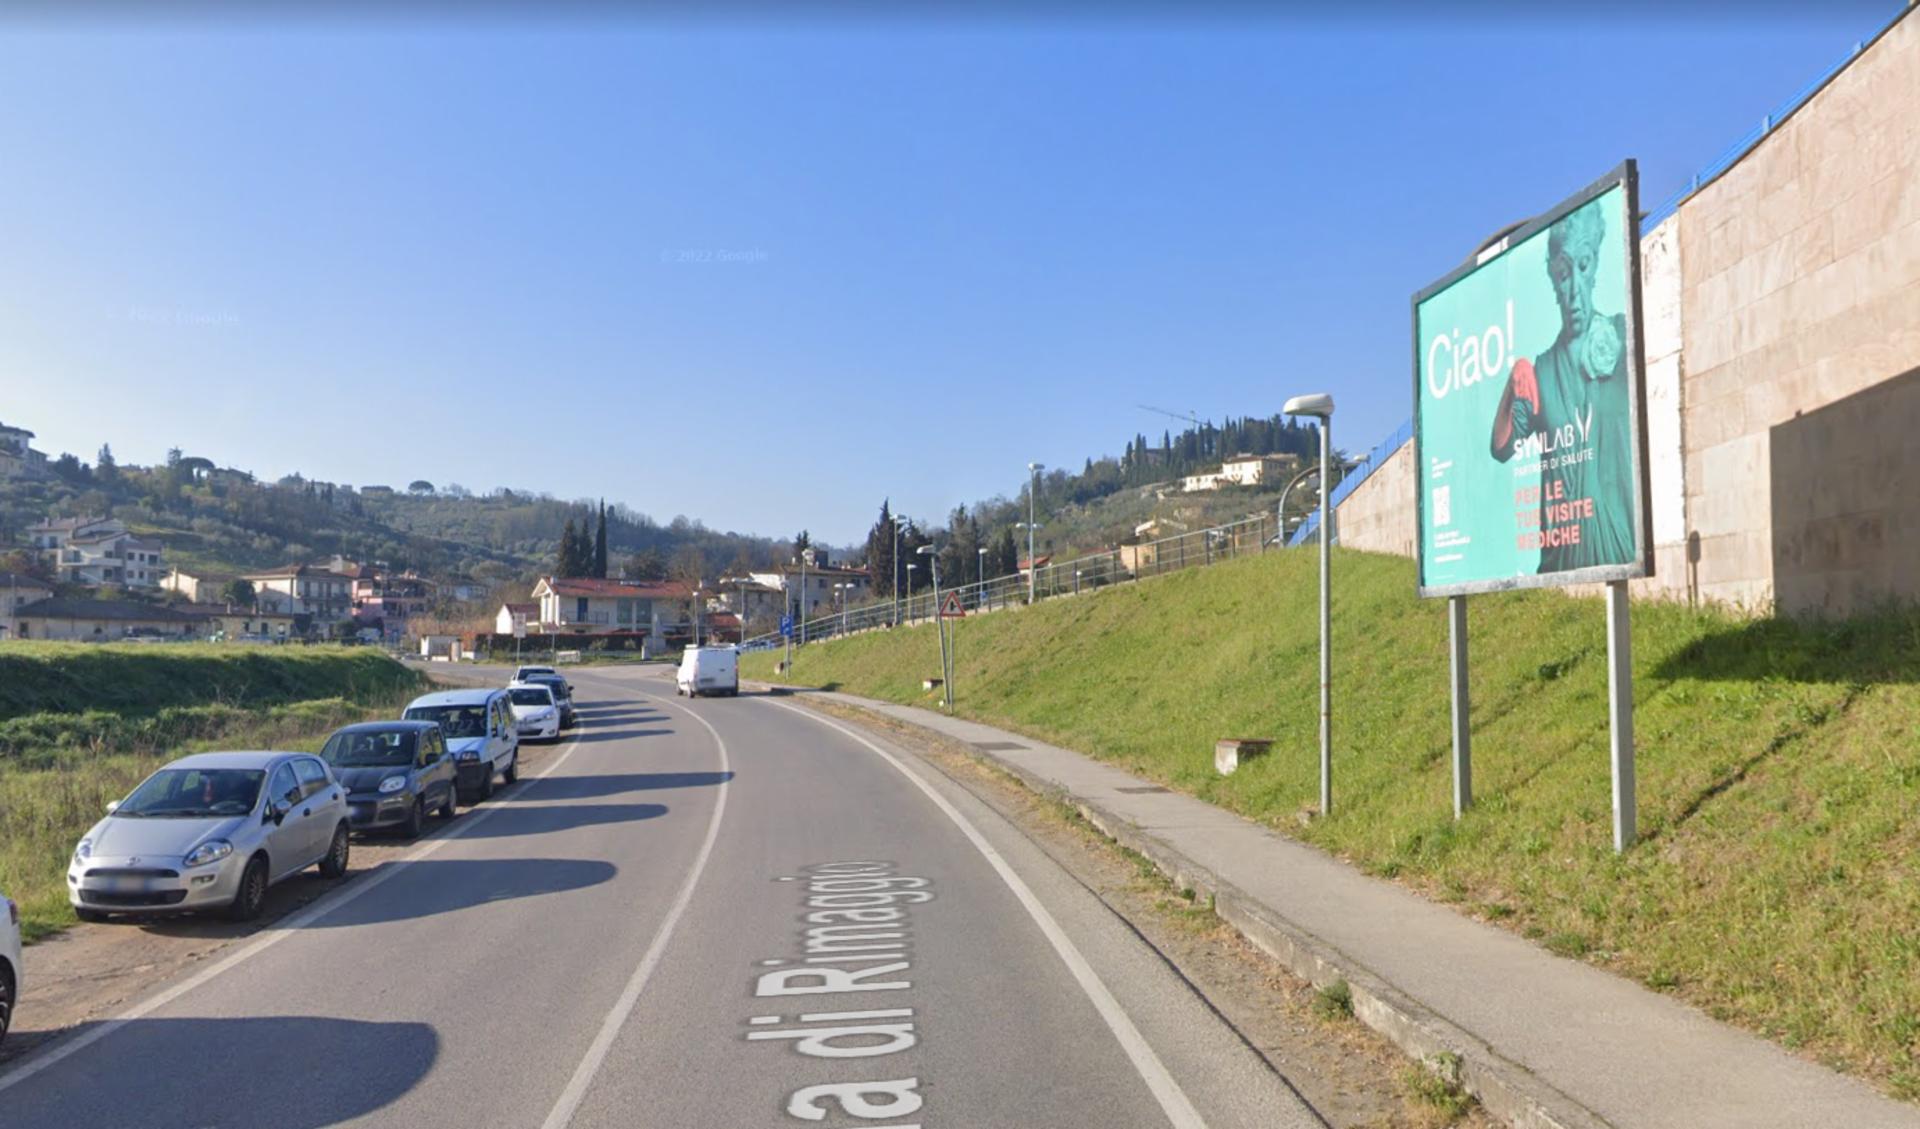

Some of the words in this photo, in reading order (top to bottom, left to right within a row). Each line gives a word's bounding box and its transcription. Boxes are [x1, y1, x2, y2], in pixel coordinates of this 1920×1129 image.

[1427, 299, 1515, 400] Ciao!
[1513, 424, 1575, 460] SYNLAB
[1561, 447, 1594, 466] SALUTE
[1515, 485, 1540, 508] PER
[1545, 480, 1562, 501] LE
[1516, 508, 1541, 529] TUE
[1546, 498, 1593, 524] VISITE
[1516, 524, 1580, 551] MEDICHE
